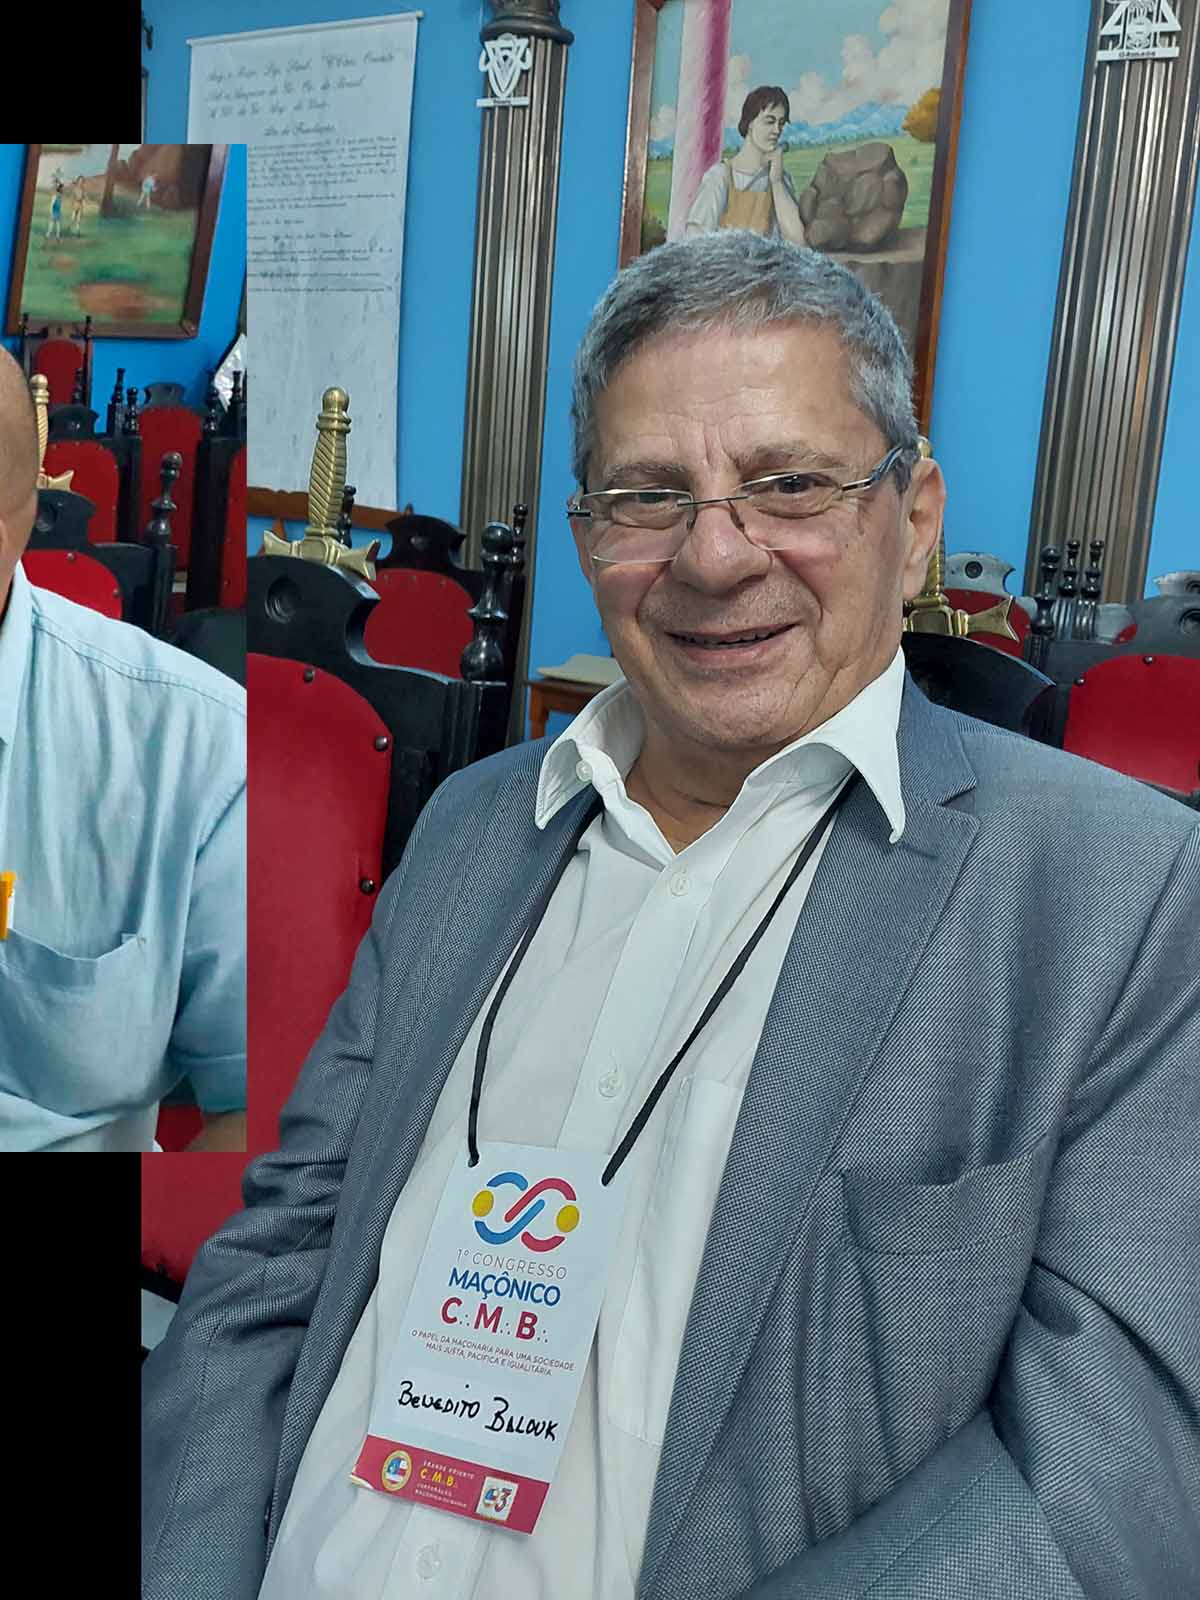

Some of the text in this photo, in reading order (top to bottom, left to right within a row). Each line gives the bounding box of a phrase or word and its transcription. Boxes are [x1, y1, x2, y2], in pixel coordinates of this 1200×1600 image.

[472, 1251, 568, 1280] CONGRESSO
[448, 1267, 561, 1307] MAÇÔNICO
[418, 1331, 439, 1343] PAPEL
[440, 1335, 451, 1345] DA
[451, 1337, 494, 1354] MAÇONARIA
[494, 1346, 514, 1359] PARA
[515, 1352, 532, 1363] UMA
[533, 1355, 575, 1372] SOCIEDADE
[426, 1341, 443, 1353] MAIS
